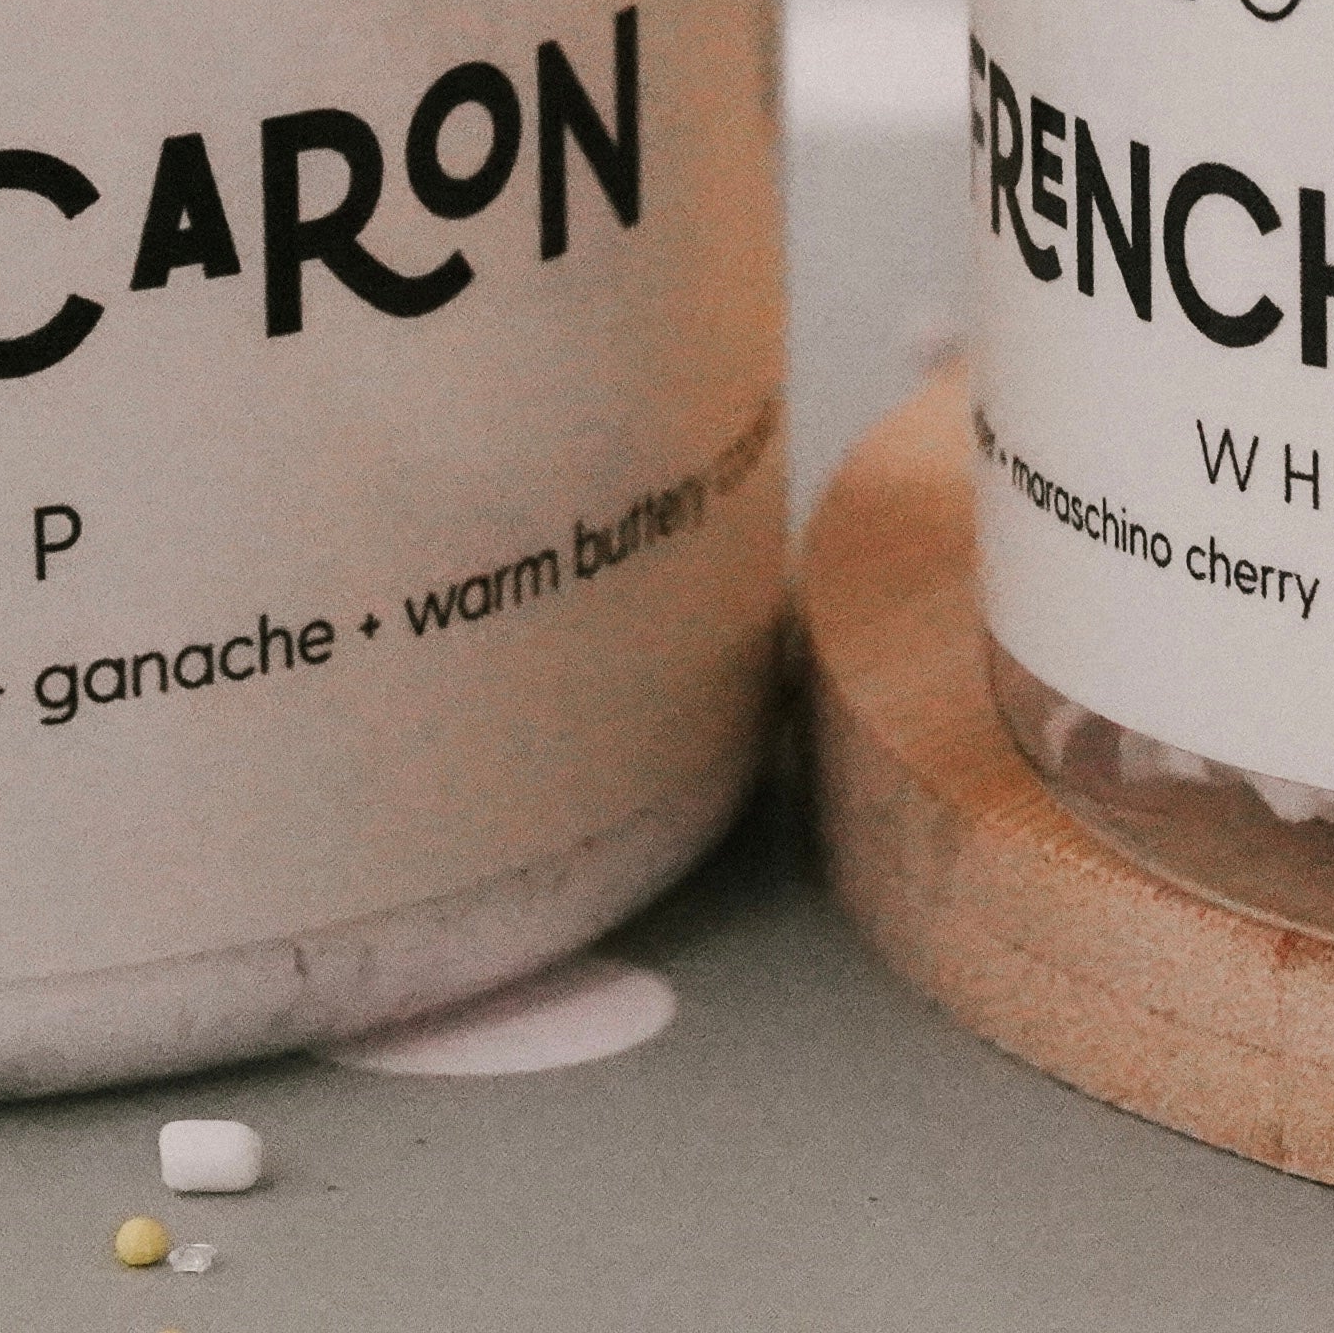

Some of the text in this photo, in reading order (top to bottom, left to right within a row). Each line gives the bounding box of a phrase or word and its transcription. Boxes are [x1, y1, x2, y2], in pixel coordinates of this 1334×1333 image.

[1012, 454, 1173, 569] maraschino
[1185, 536, 1320, 620] cherry
[33, 613, 336, 727] ganache
[404, 548, 561, 637] warm
